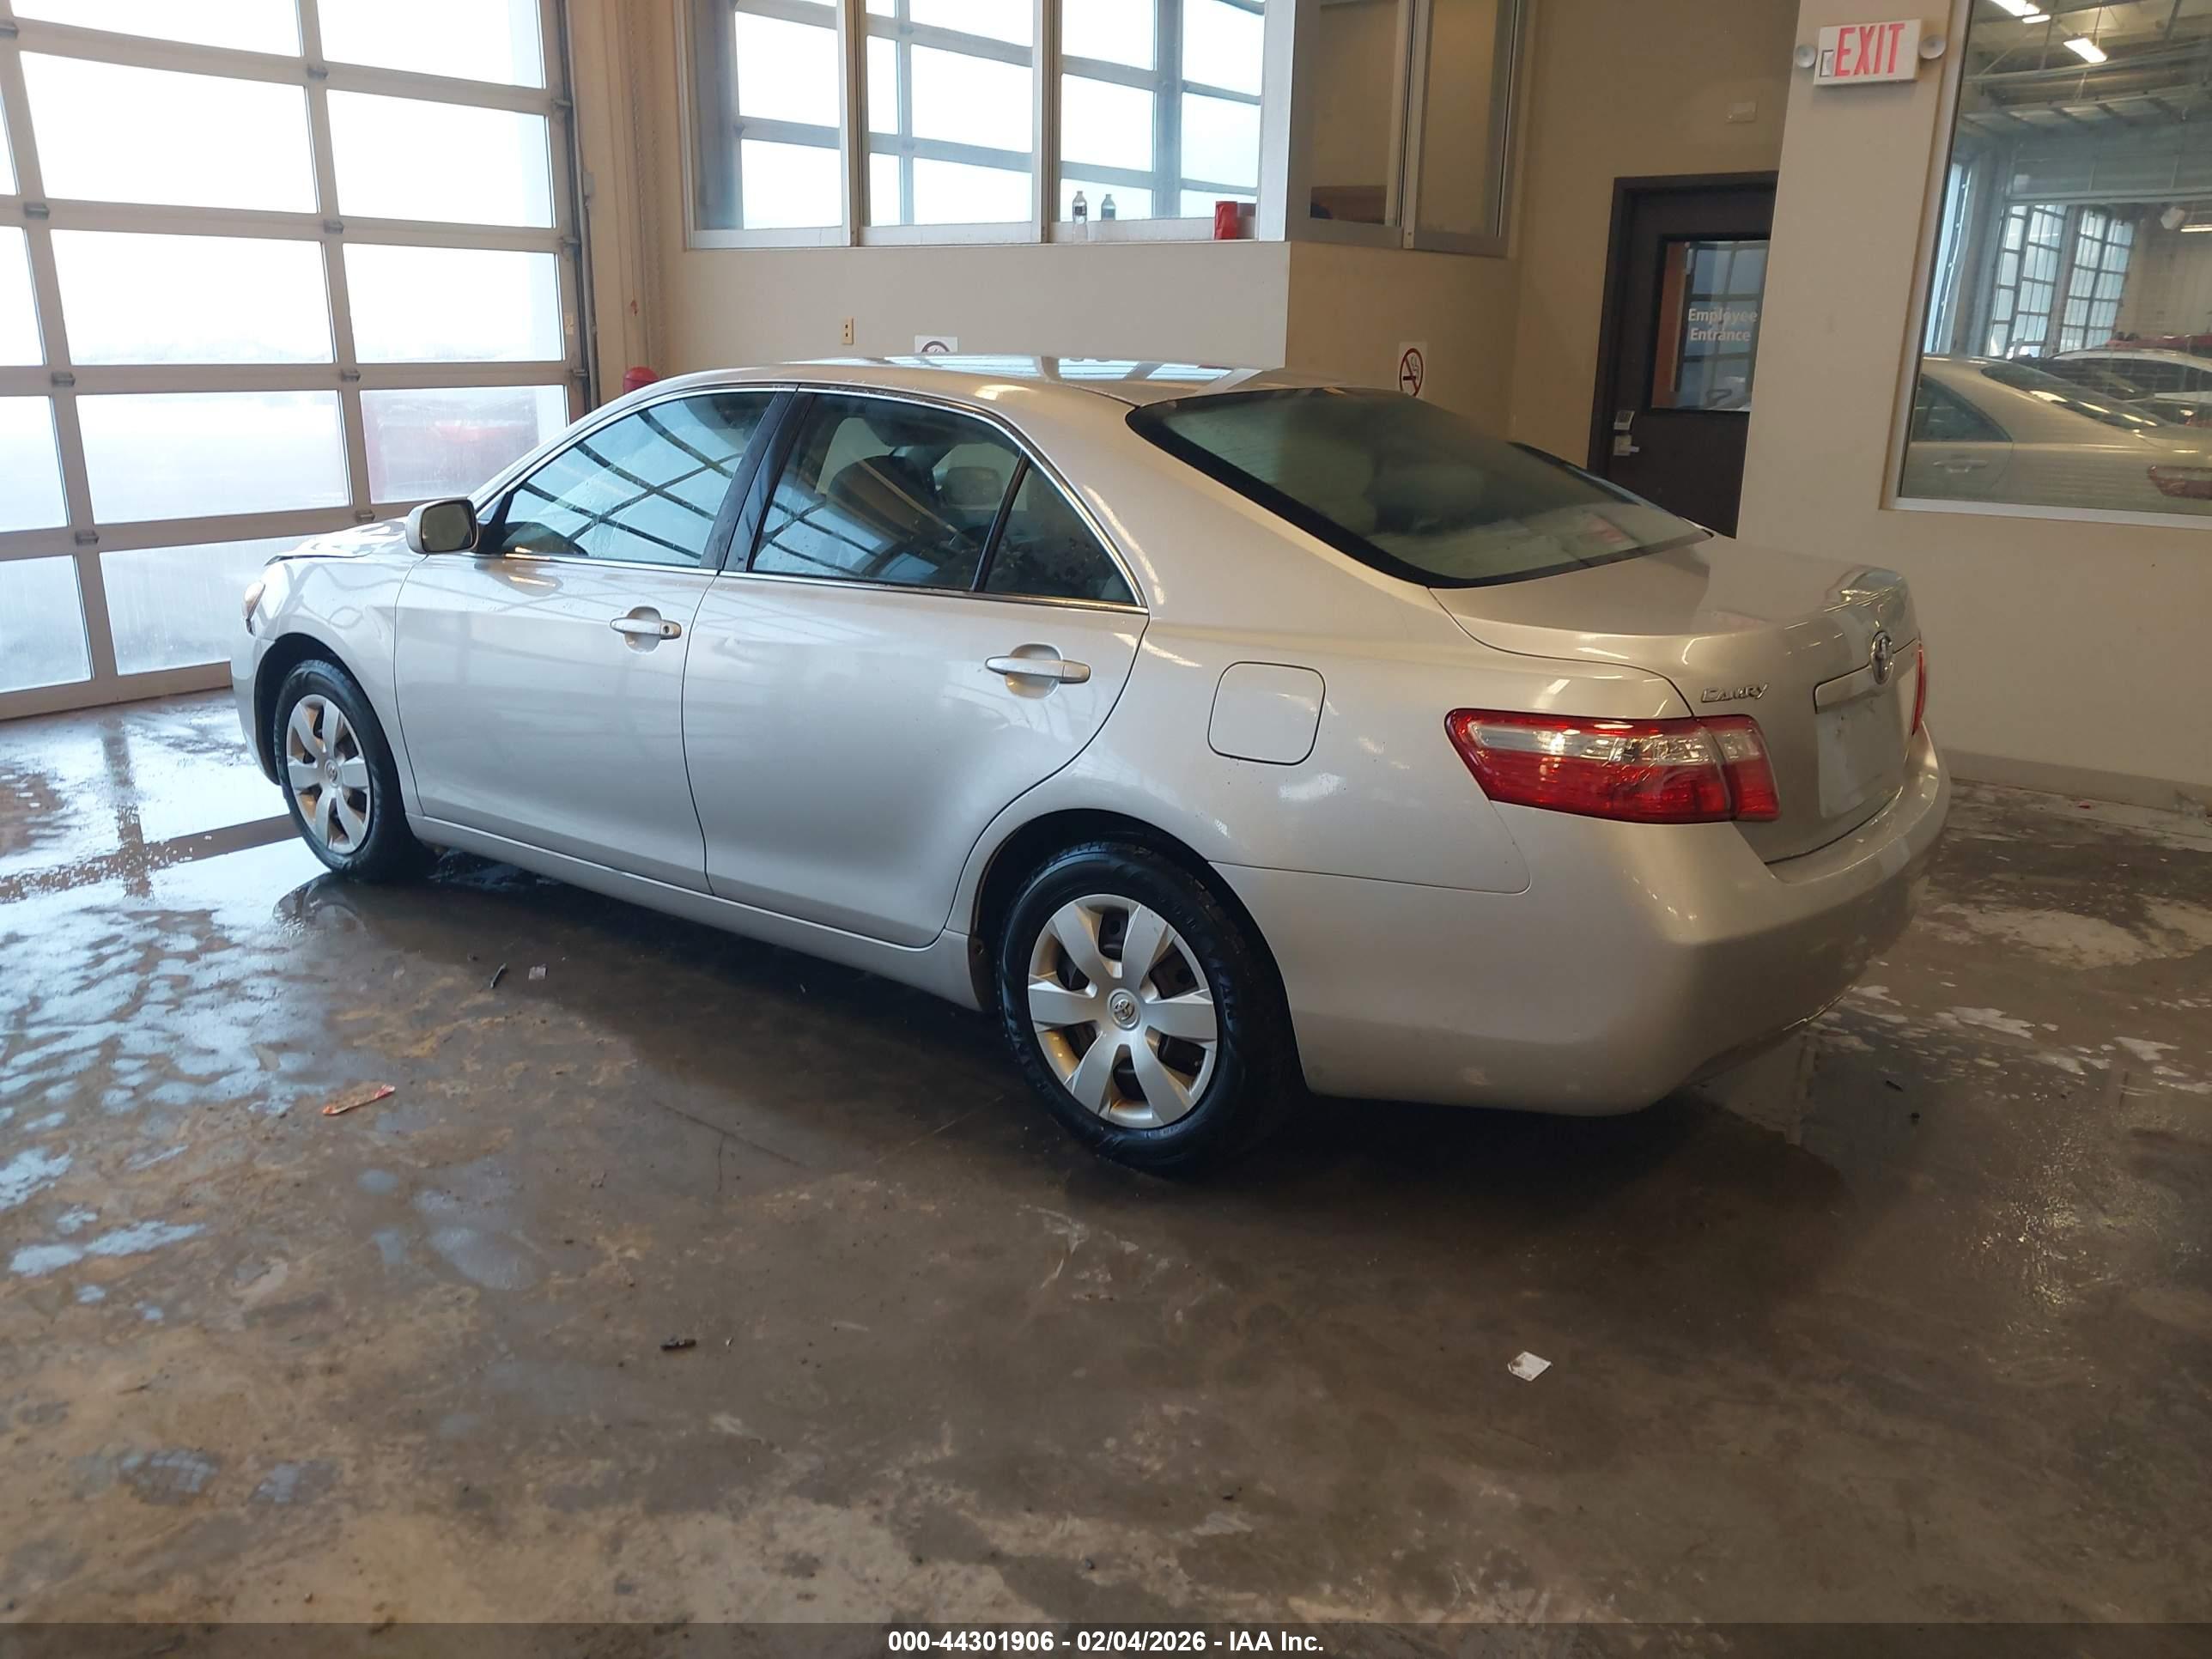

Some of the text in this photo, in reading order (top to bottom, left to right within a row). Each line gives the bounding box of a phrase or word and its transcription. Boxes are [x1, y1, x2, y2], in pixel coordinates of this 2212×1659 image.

[1834, 22, 1905, 76] EXIT
[1688, 307, 1758, 325] Employee
[1690, 328, 1752, 342] Entrance
